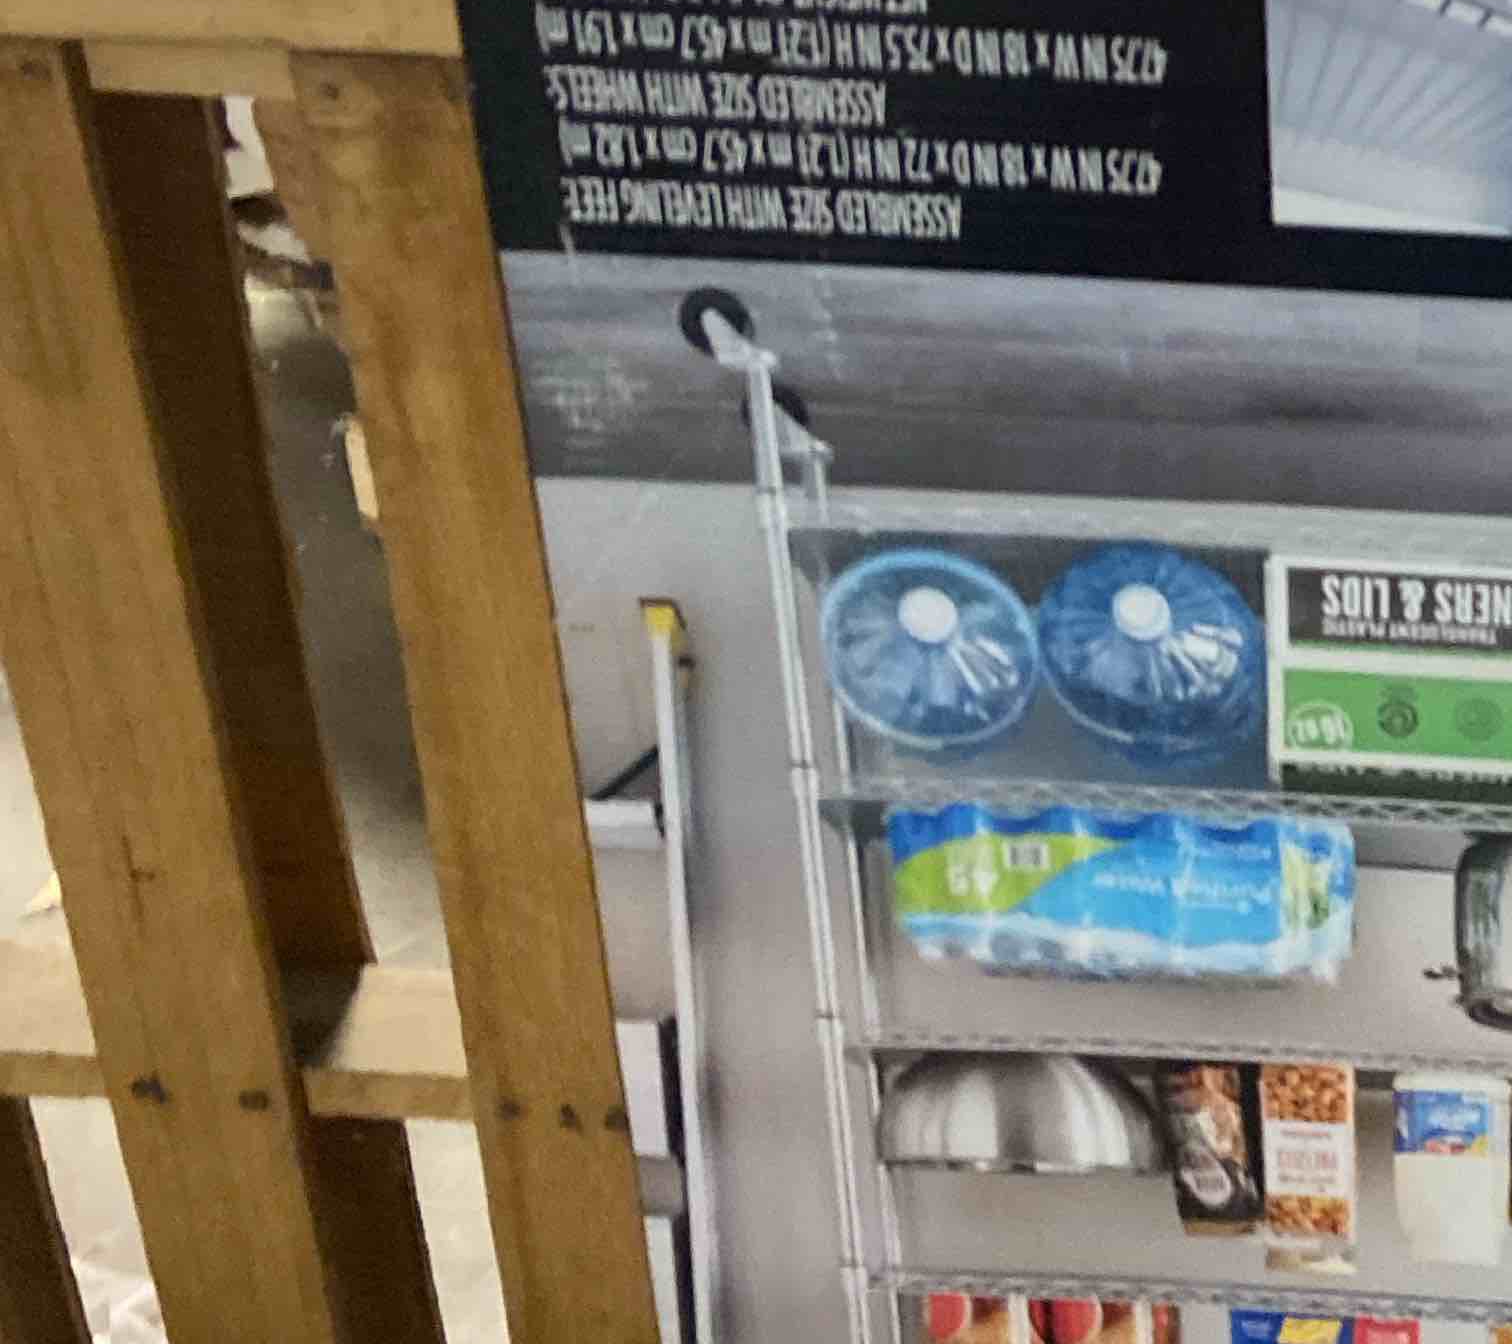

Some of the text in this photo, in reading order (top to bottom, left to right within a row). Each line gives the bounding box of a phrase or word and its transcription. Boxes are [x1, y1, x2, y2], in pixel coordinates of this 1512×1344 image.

[746, 16, 772, 55] m
[834, 21, 854, 70] H
[952, 26, 973, 76] D
[1053, 32, 1080, 81] W
[644, 68, 709, 117] WITH
[706, 71, 756, 121] SIZE
[757, 74, 886, 126] ASSEMBLED
[767, 131, 793, 168] m
[852, 135, 872, 180] H
[951, 139, 971, 183] D
[1050, 145, 1076, 191] W
[620, 176, 723, 227] LEVELING
[724, 183, 788, 231] WITH
[788, 187, 834, 233] SIZE
[835, 188, 961, 239] ASSEMBLED
[1320, 574, 1389, 621] LIDS
[1399, 579, 1427, 622] &
